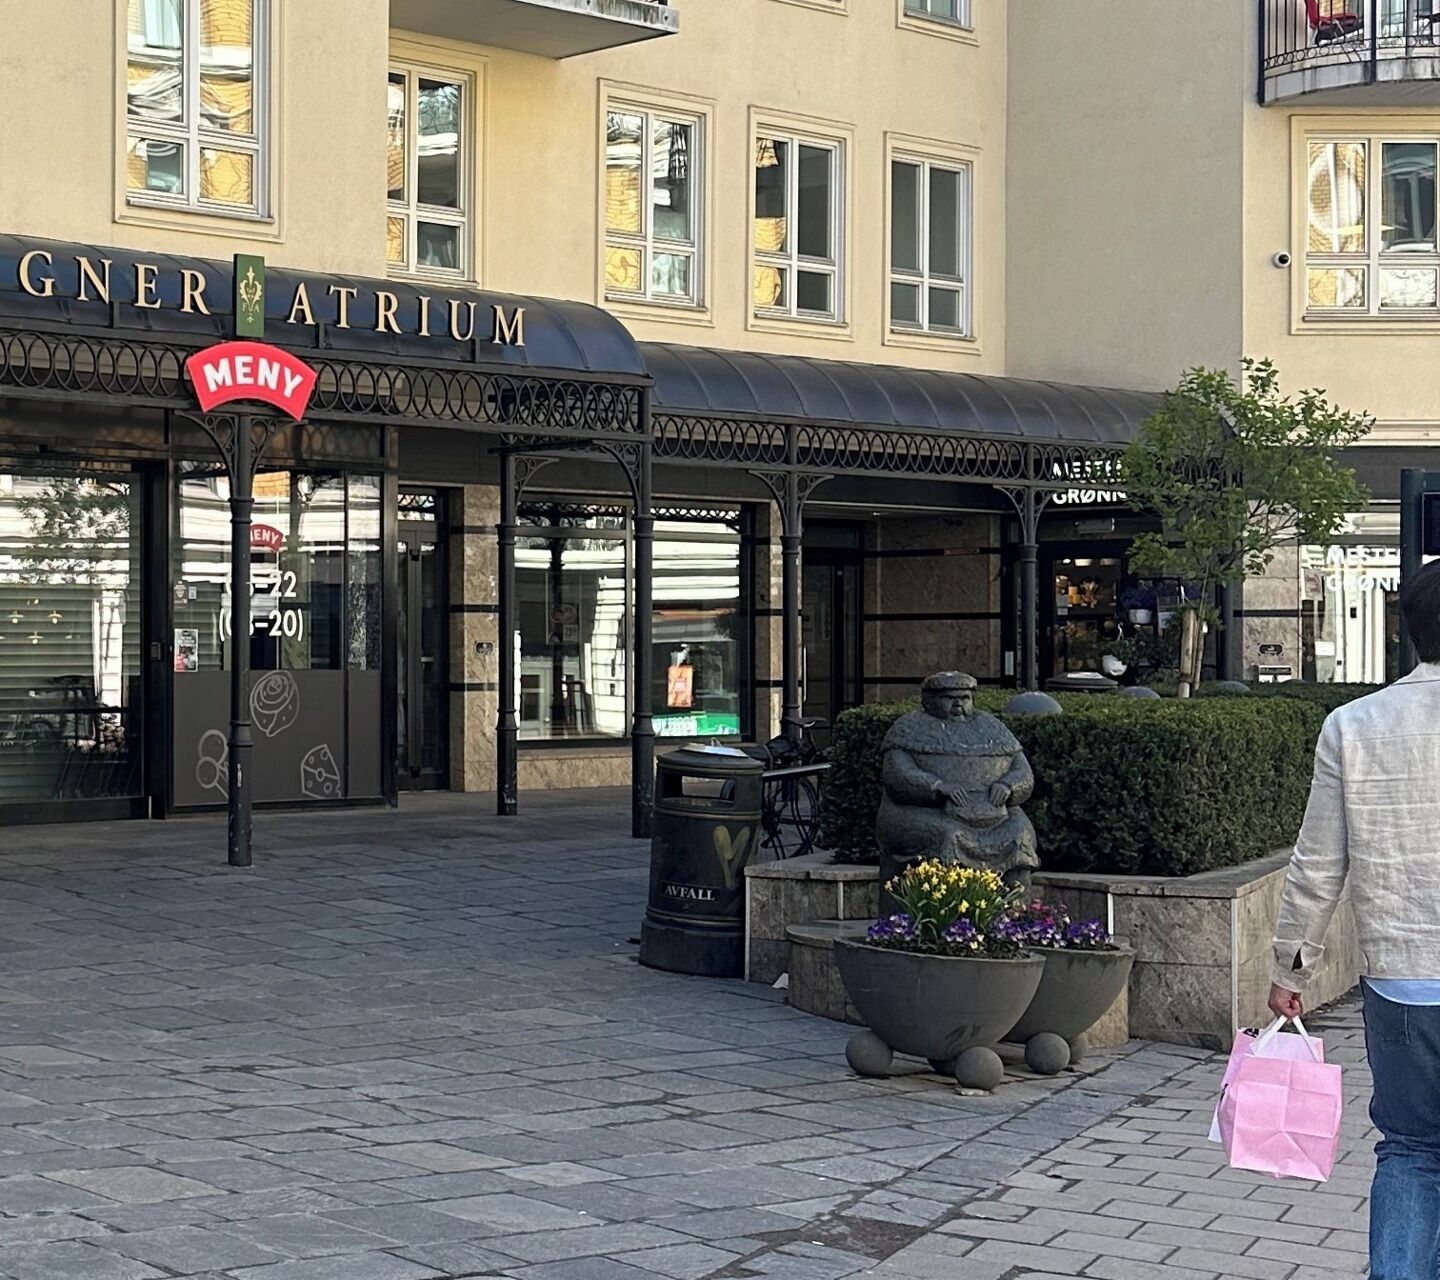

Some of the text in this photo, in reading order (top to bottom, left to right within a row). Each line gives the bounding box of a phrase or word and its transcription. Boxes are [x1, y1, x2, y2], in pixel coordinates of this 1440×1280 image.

[287, 281, 527, 347] ATRIUM
[202, 355, 303, 398] MENY
[664, 884, 716, 901] AVFALL
